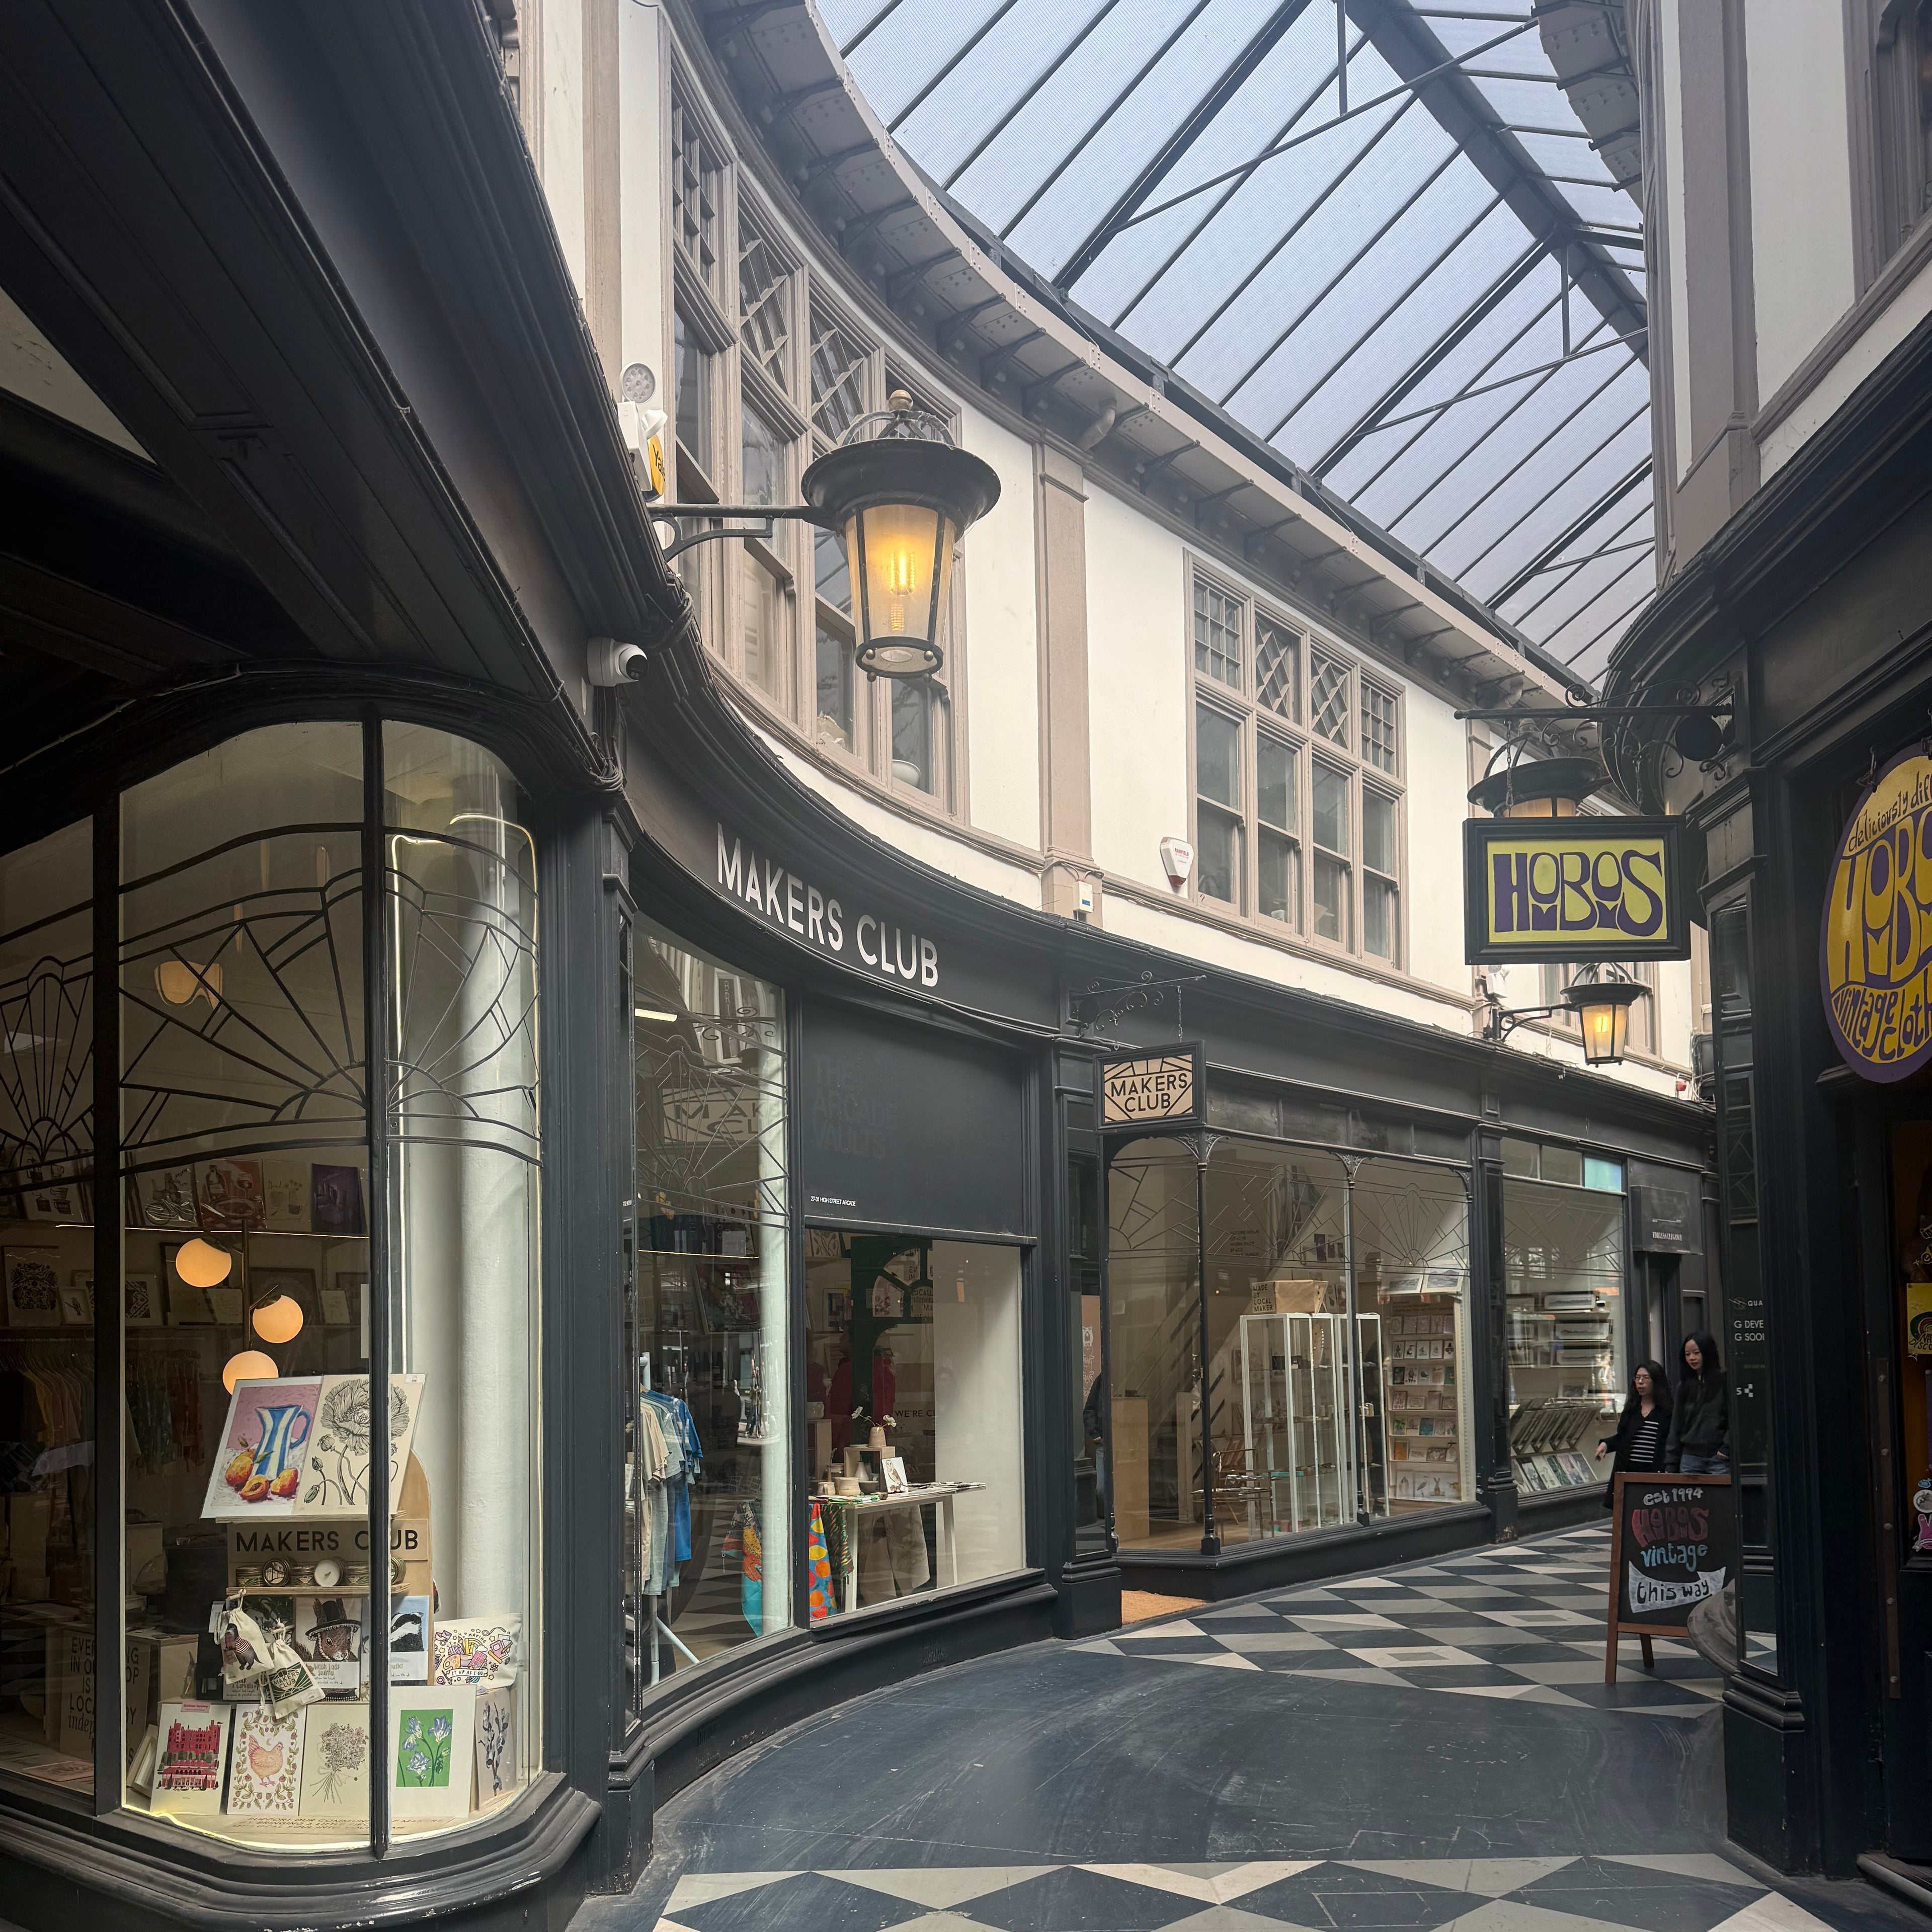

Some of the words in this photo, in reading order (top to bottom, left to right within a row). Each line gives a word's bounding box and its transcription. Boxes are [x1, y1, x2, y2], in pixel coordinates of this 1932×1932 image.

[1848, 791, 1908, 852] deliciously
[1493, 849, 1663, 936] HOBOS
[717, 822, 844, 952] MAKERS
[856, 914, 939, 988] CLUB
[1833, 988, 1898, 1058] vintage
[1879, 967, 1932, 1061] cloth
[1111, 1073, 1187, 1097] MAKERS
[1124, 1093, 1171, 1112] CLUB
[1744, 1320, 1764, 1328] DEVE
[1643, 1490, 1669, 1505] est
[1671, 1487, 1703, 1502] 1994
[1631, 1507, 1709, 1547] HOBOS
[236, 1530, 339, 1552] MAKERS
[355, 1530, 418, 1550] CUB
[1641, 1543, 1708, 1572] vintage
[1637, 1581, 1677, 1604] this
[1682, 1579, 1713, 1598] way
[468, 1633, 487, 1643] MAKING
[70, 1655, 80, 1673] IN
[274, 1670, 300, 1685] MAKERS
[279, 1678, 297, 1689] CLUB
